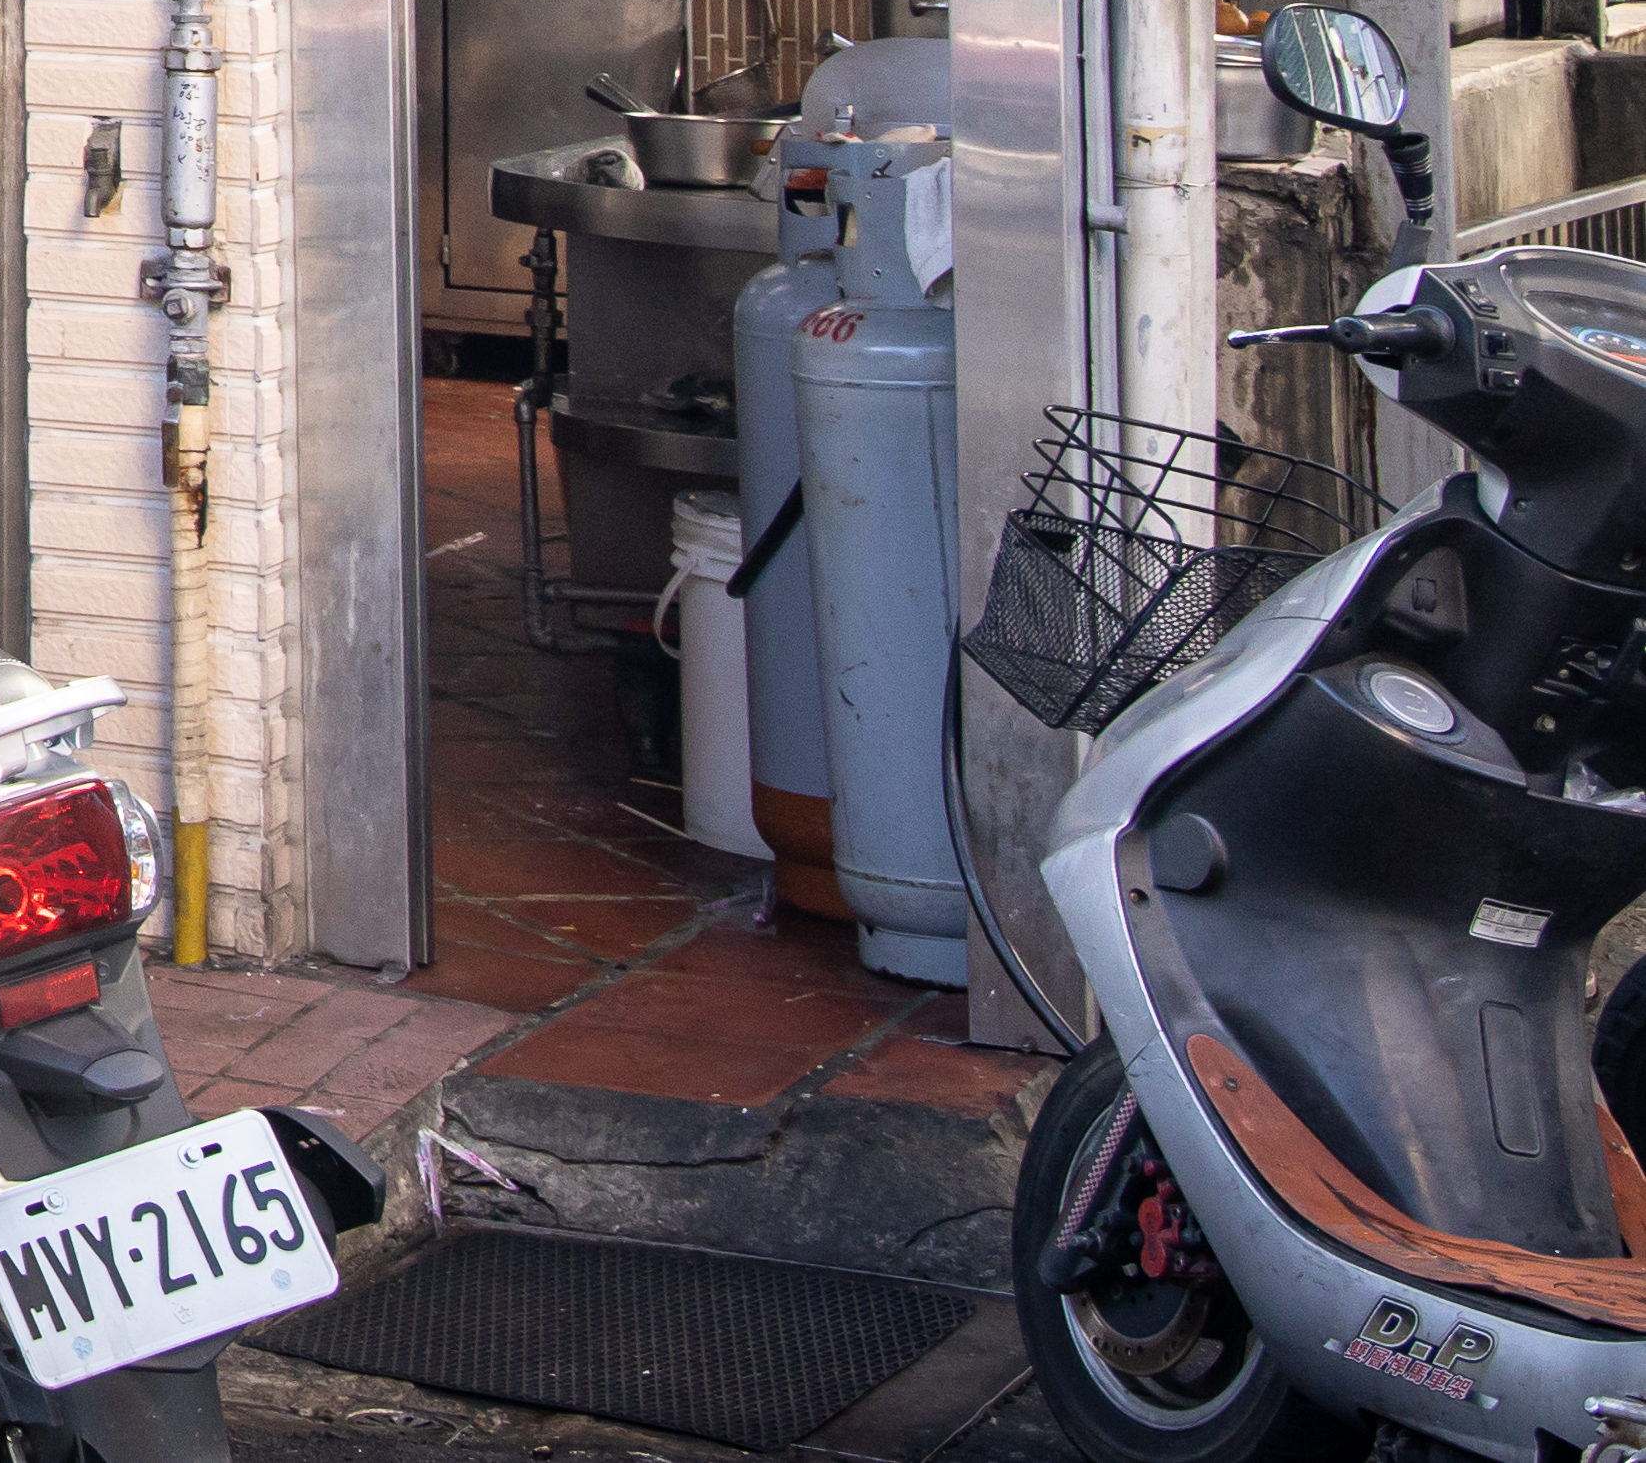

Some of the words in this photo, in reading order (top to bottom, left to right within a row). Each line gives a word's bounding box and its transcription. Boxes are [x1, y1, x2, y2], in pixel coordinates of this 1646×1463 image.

[1344, 1337, 1474, 1400] 雙層悍馬車架
